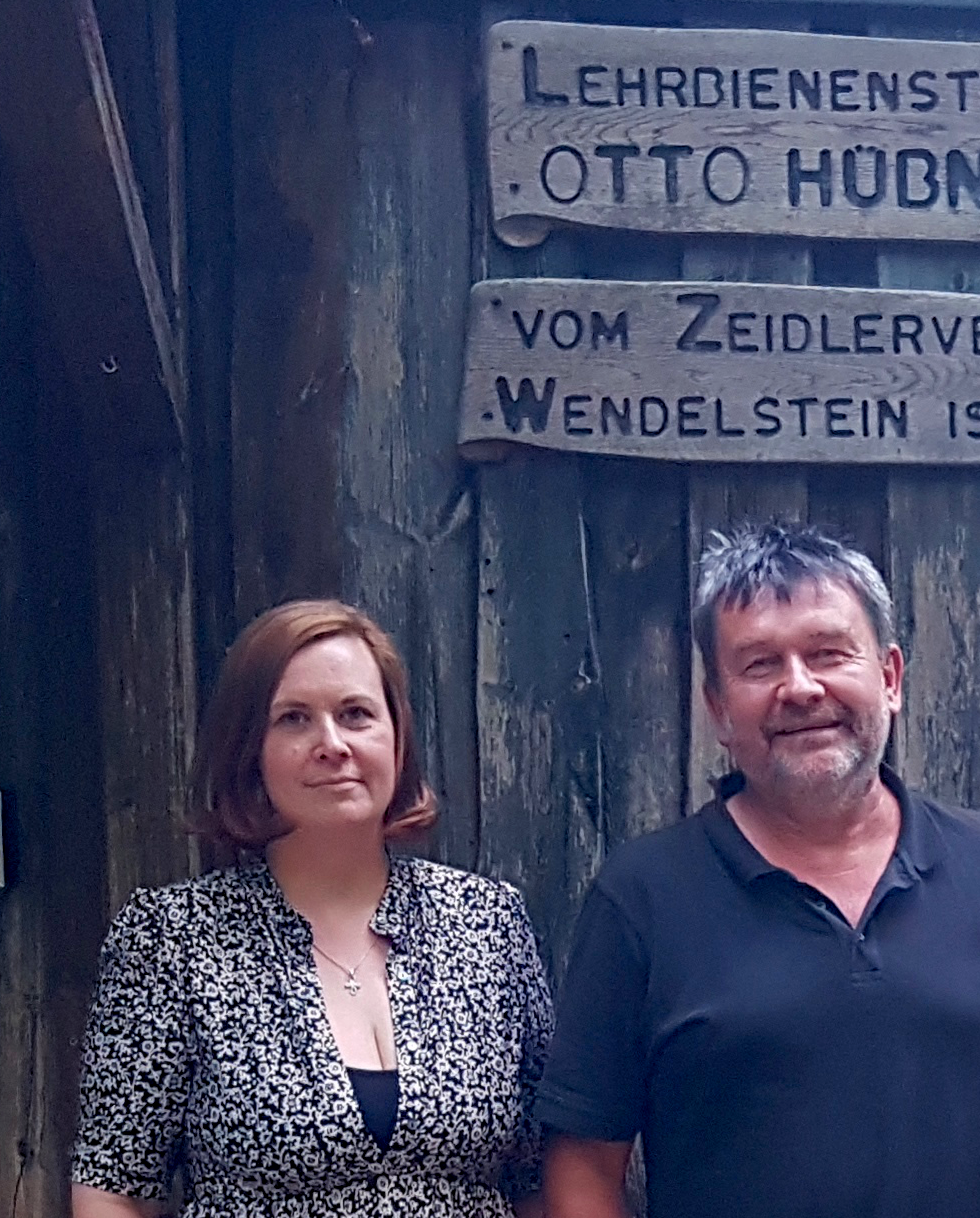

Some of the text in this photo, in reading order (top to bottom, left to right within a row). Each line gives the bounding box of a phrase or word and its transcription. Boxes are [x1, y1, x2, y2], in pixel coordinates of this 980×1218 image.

[540, 145, 751, 206] OTTO
[511, 310, 630, 351] VOM
[495, 376, 909, 440] WENDELSTEIN
